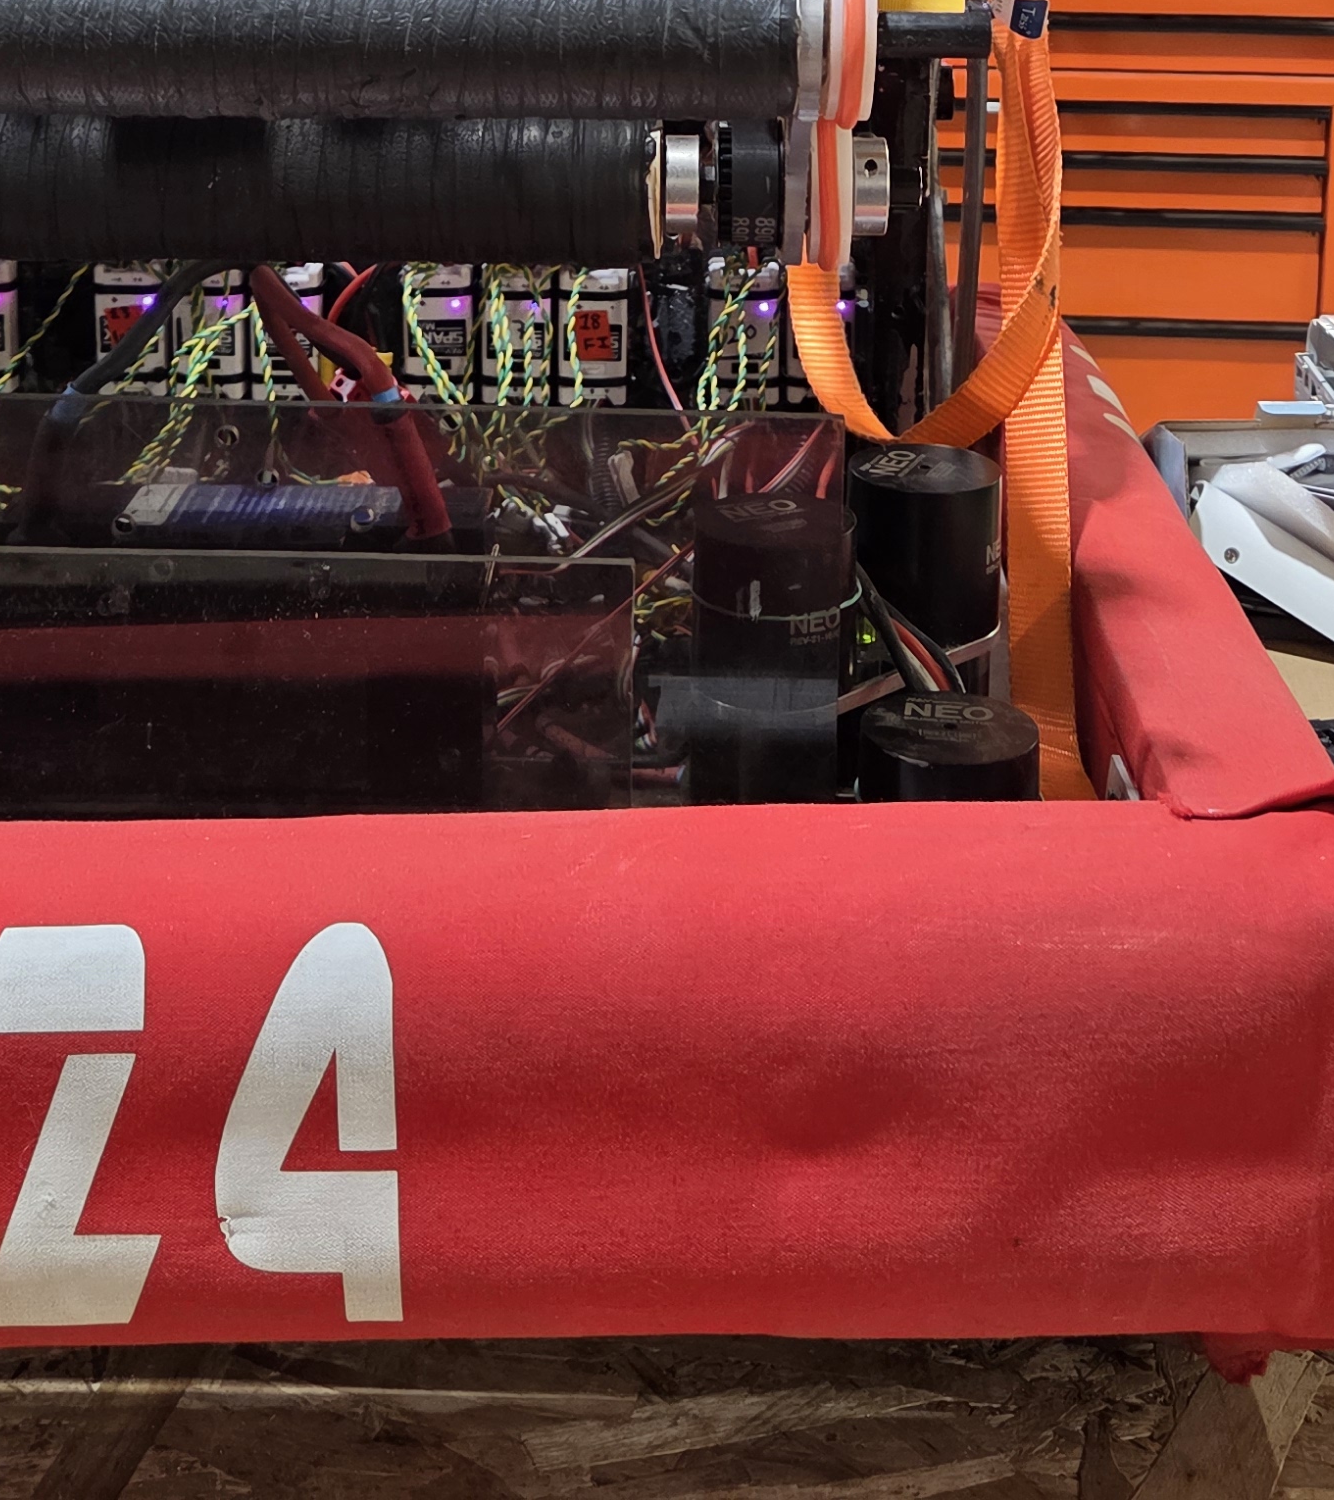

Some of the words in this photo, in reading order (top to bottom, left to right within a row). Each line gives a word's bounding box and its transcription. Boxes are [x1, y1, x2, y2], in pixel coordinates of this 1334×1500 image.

[754, 216, 776, 242] 890
[578, 312, 601, 331] 18
[869, 450, 917, 478] NEO
[720, 498, 798, 521] NEO
[986, 541, 1001, 566] NE
[789, 606, 841, 636] NEO
[903, 701, 995, 721] NEO
